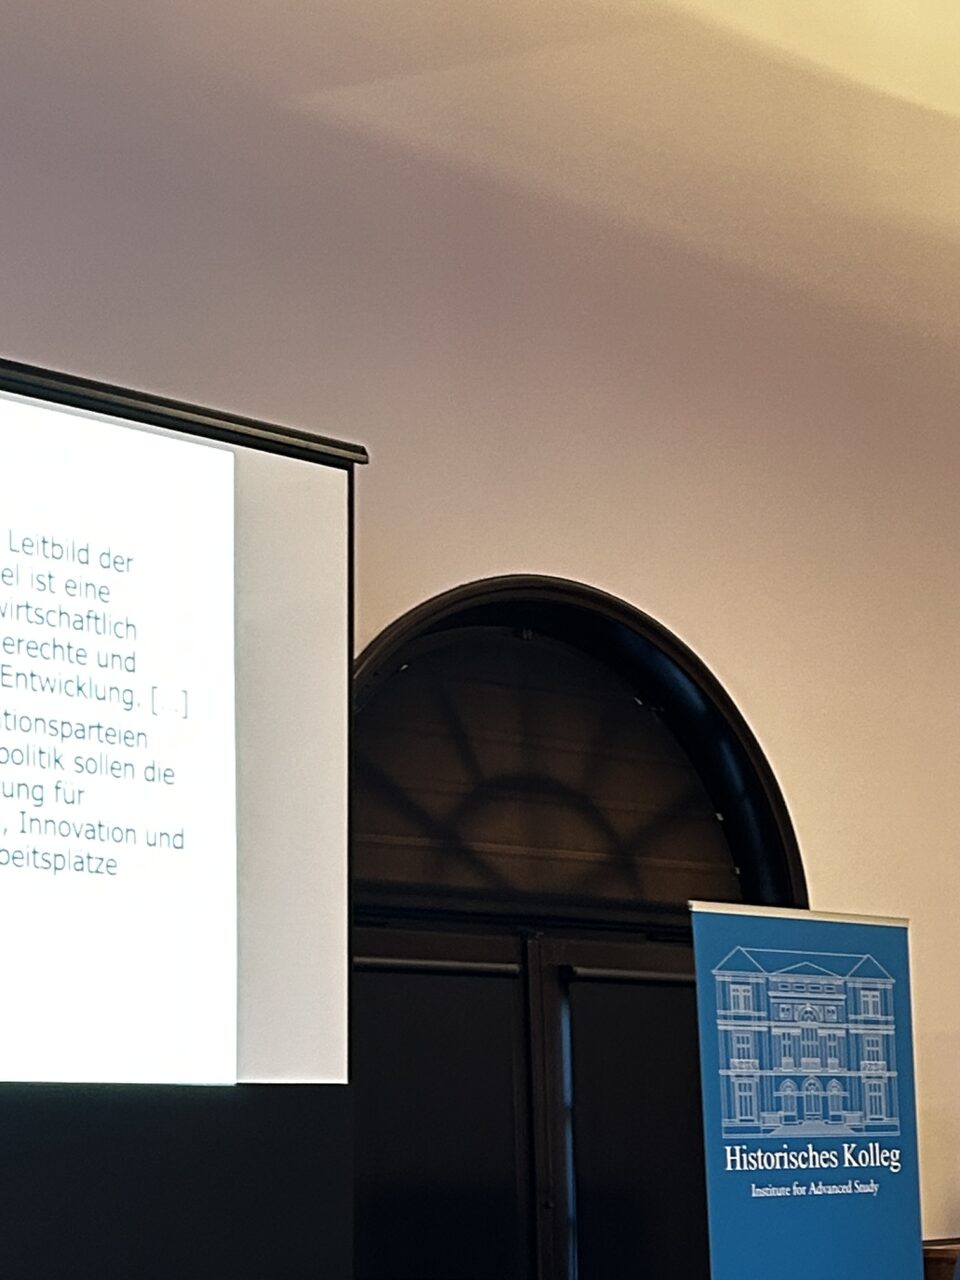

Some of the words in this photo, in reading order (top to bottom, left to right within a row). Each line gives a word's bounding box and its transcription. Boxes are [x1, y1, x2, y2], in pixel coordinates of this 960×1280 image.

[9, 528, 90, 566] Leitbild
[99, 545, 134, 573] der
[31, 566, 56, 594] ist
[65, 576, 111, 604] eine
[2, 636, 88, 666] erechte
[97, 651, 136, 673] und
[1, 664, 141, 711] Entwicklung.
[74, 752, 135, 780] sollen
[144, 760, 175, 785] die
[2, 781, 44, 807] ung
[20, 811, 137, 845] Innovation
[146, 828, 185, 850] und
[725, 1144, 838, 1171] Historisches
[842, 1143, 901, 1173] Kolleg
[751, 1184, 791, 1198] Institute
[792, 1181, 807, 1196] for
[808, 1180, 853, 1196] Advanced
[854, 1179, 880, 1196] Study
